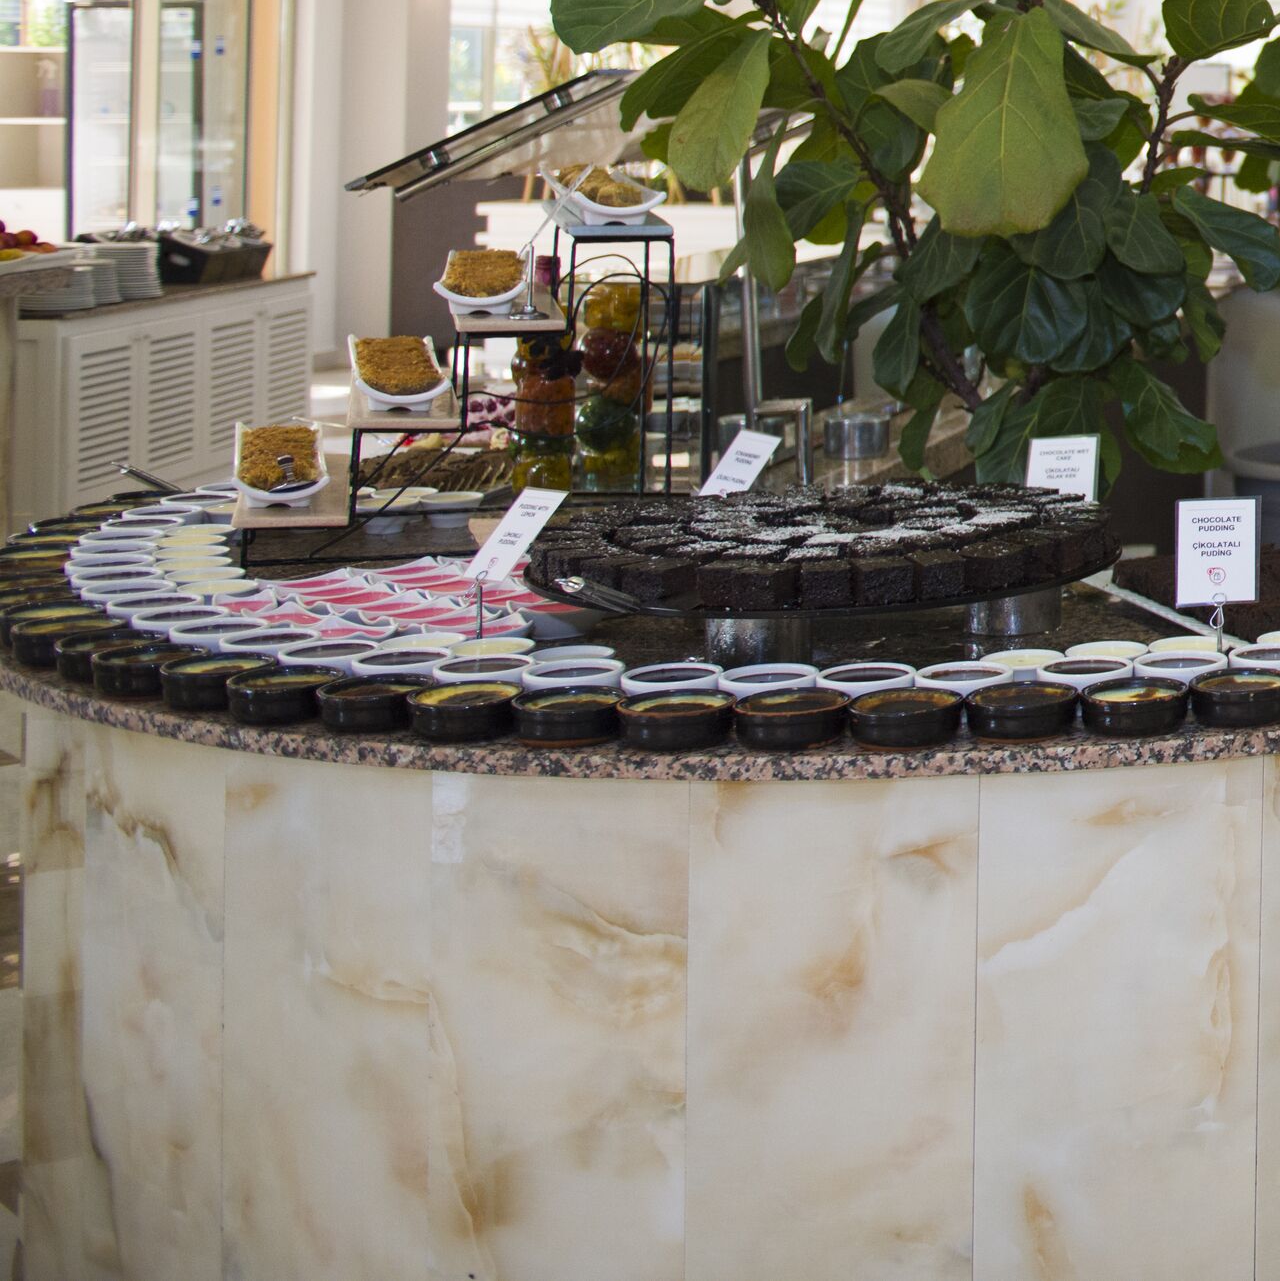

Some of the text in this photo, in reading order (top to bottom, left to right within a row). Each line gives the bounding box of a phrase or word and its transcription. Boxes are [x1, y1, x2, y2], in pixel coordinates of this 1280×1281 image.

[1191, 516, 1242, 524] CHOCOLATE
[1198, 524, 1236, 532] PUDDING
[1192, 541, 1241, 550] ÇİKOLATALI
[1201, 549, 1232, 557] PUDİNG
